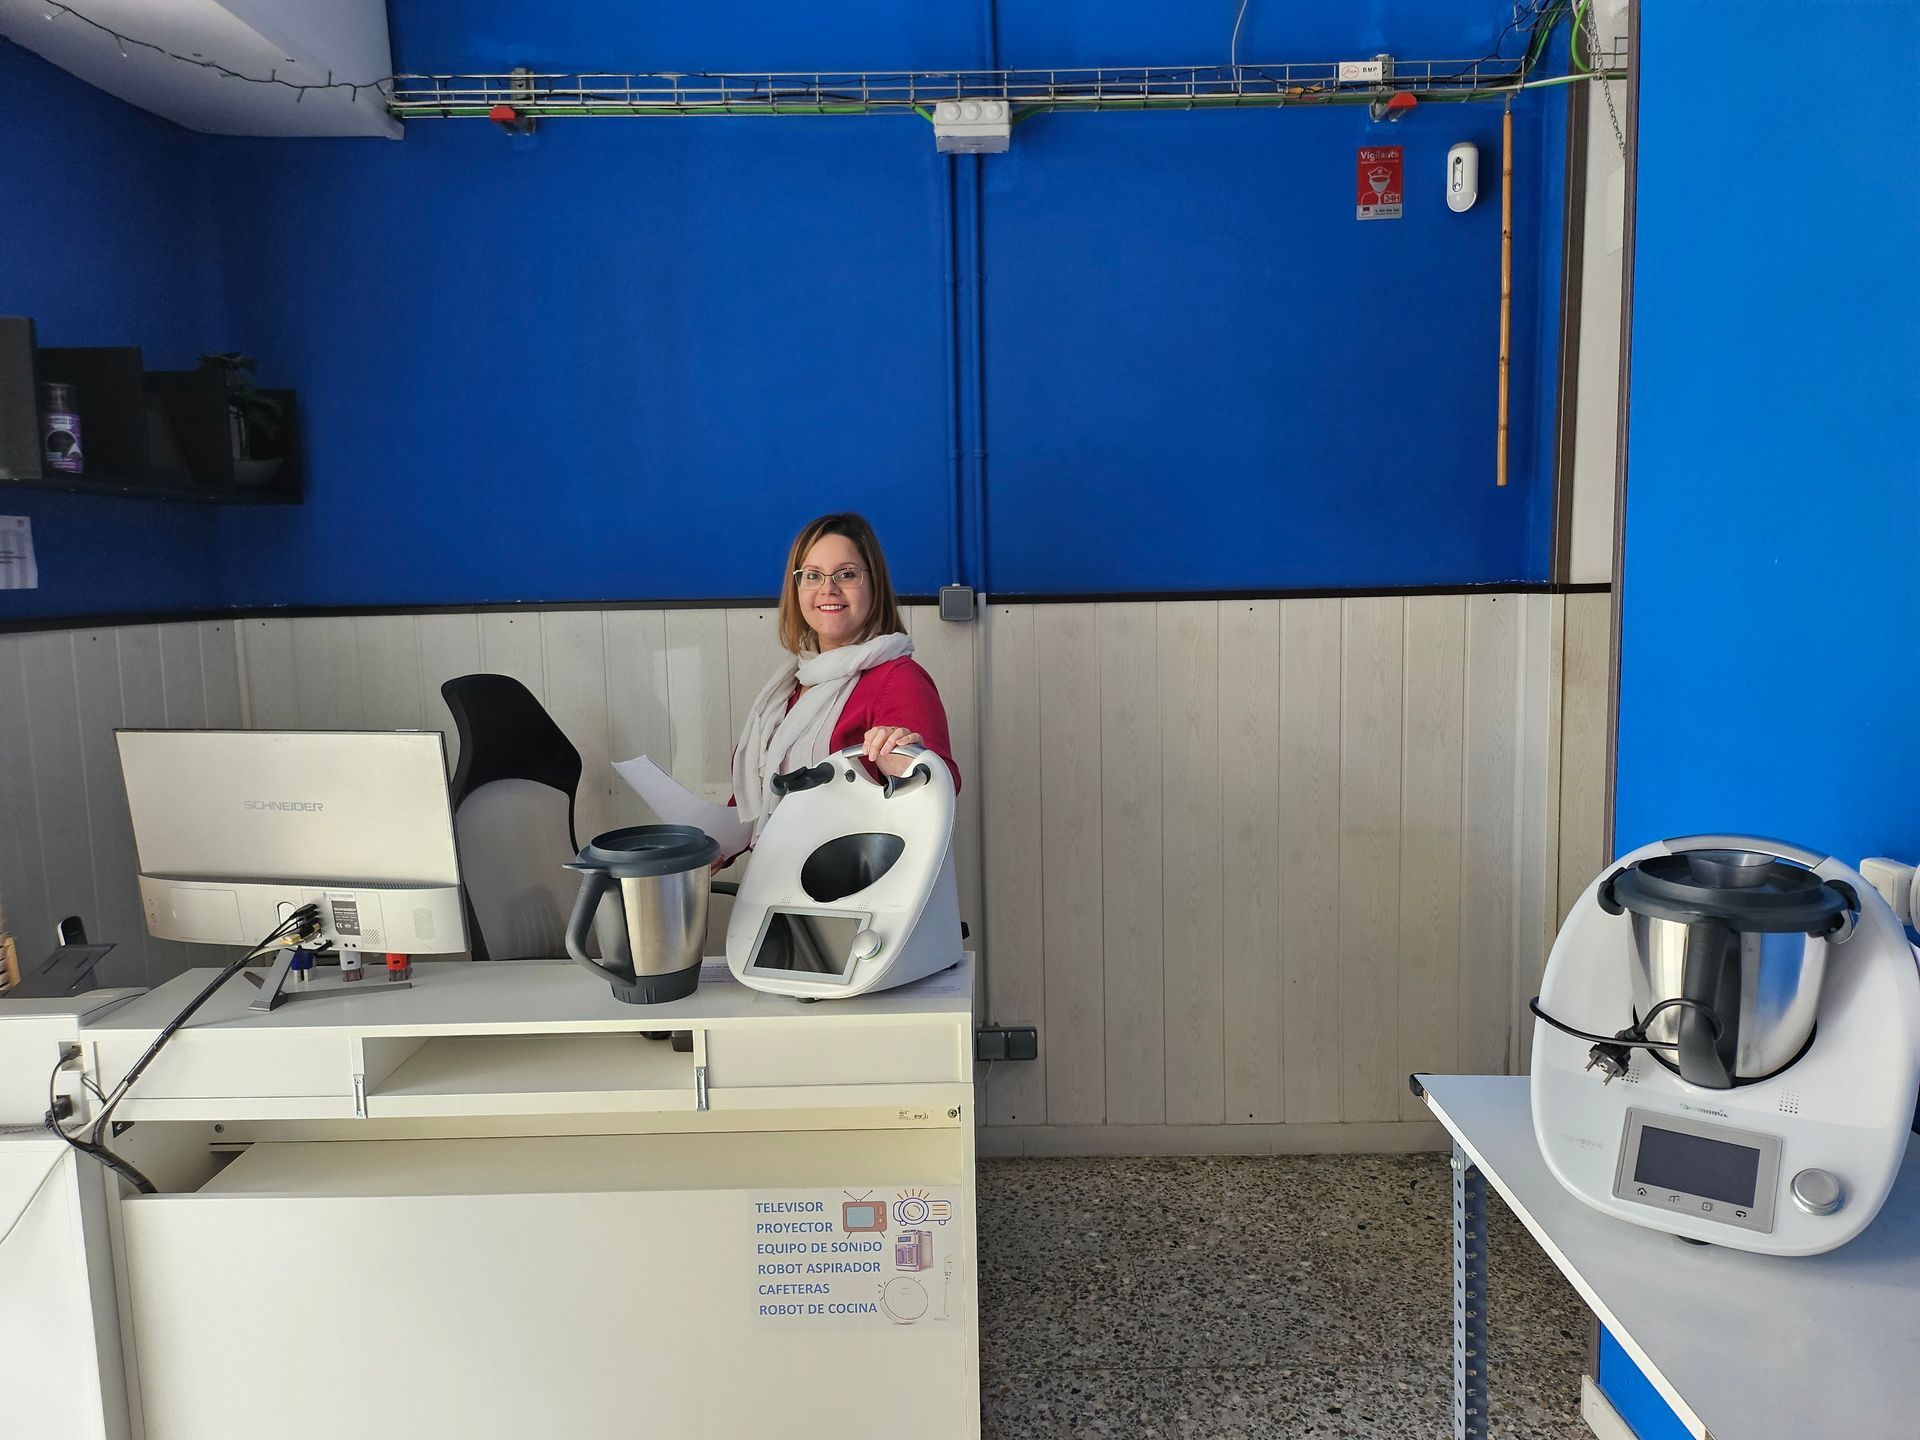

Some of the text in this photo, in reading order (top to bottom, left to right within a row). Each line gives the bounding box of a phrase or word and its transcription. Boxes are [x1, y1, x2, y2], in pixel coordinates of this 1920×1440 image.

[243, 800, 324, 812] SCHNEIDER
[755, 1201, 824, 1213] TELEVISOR
[756, 1222, 833, 1234] PROYECTOR
[757, 1241, 882, 1255] EQUIPO DE SONIDO
[758, 1262, 881, 1275] ROBOT ASPIRADOR
[758, 1283, 830, 1295] CAFETERAS
[759, 1303, 878, 1315] ROBOT DE COCINA
